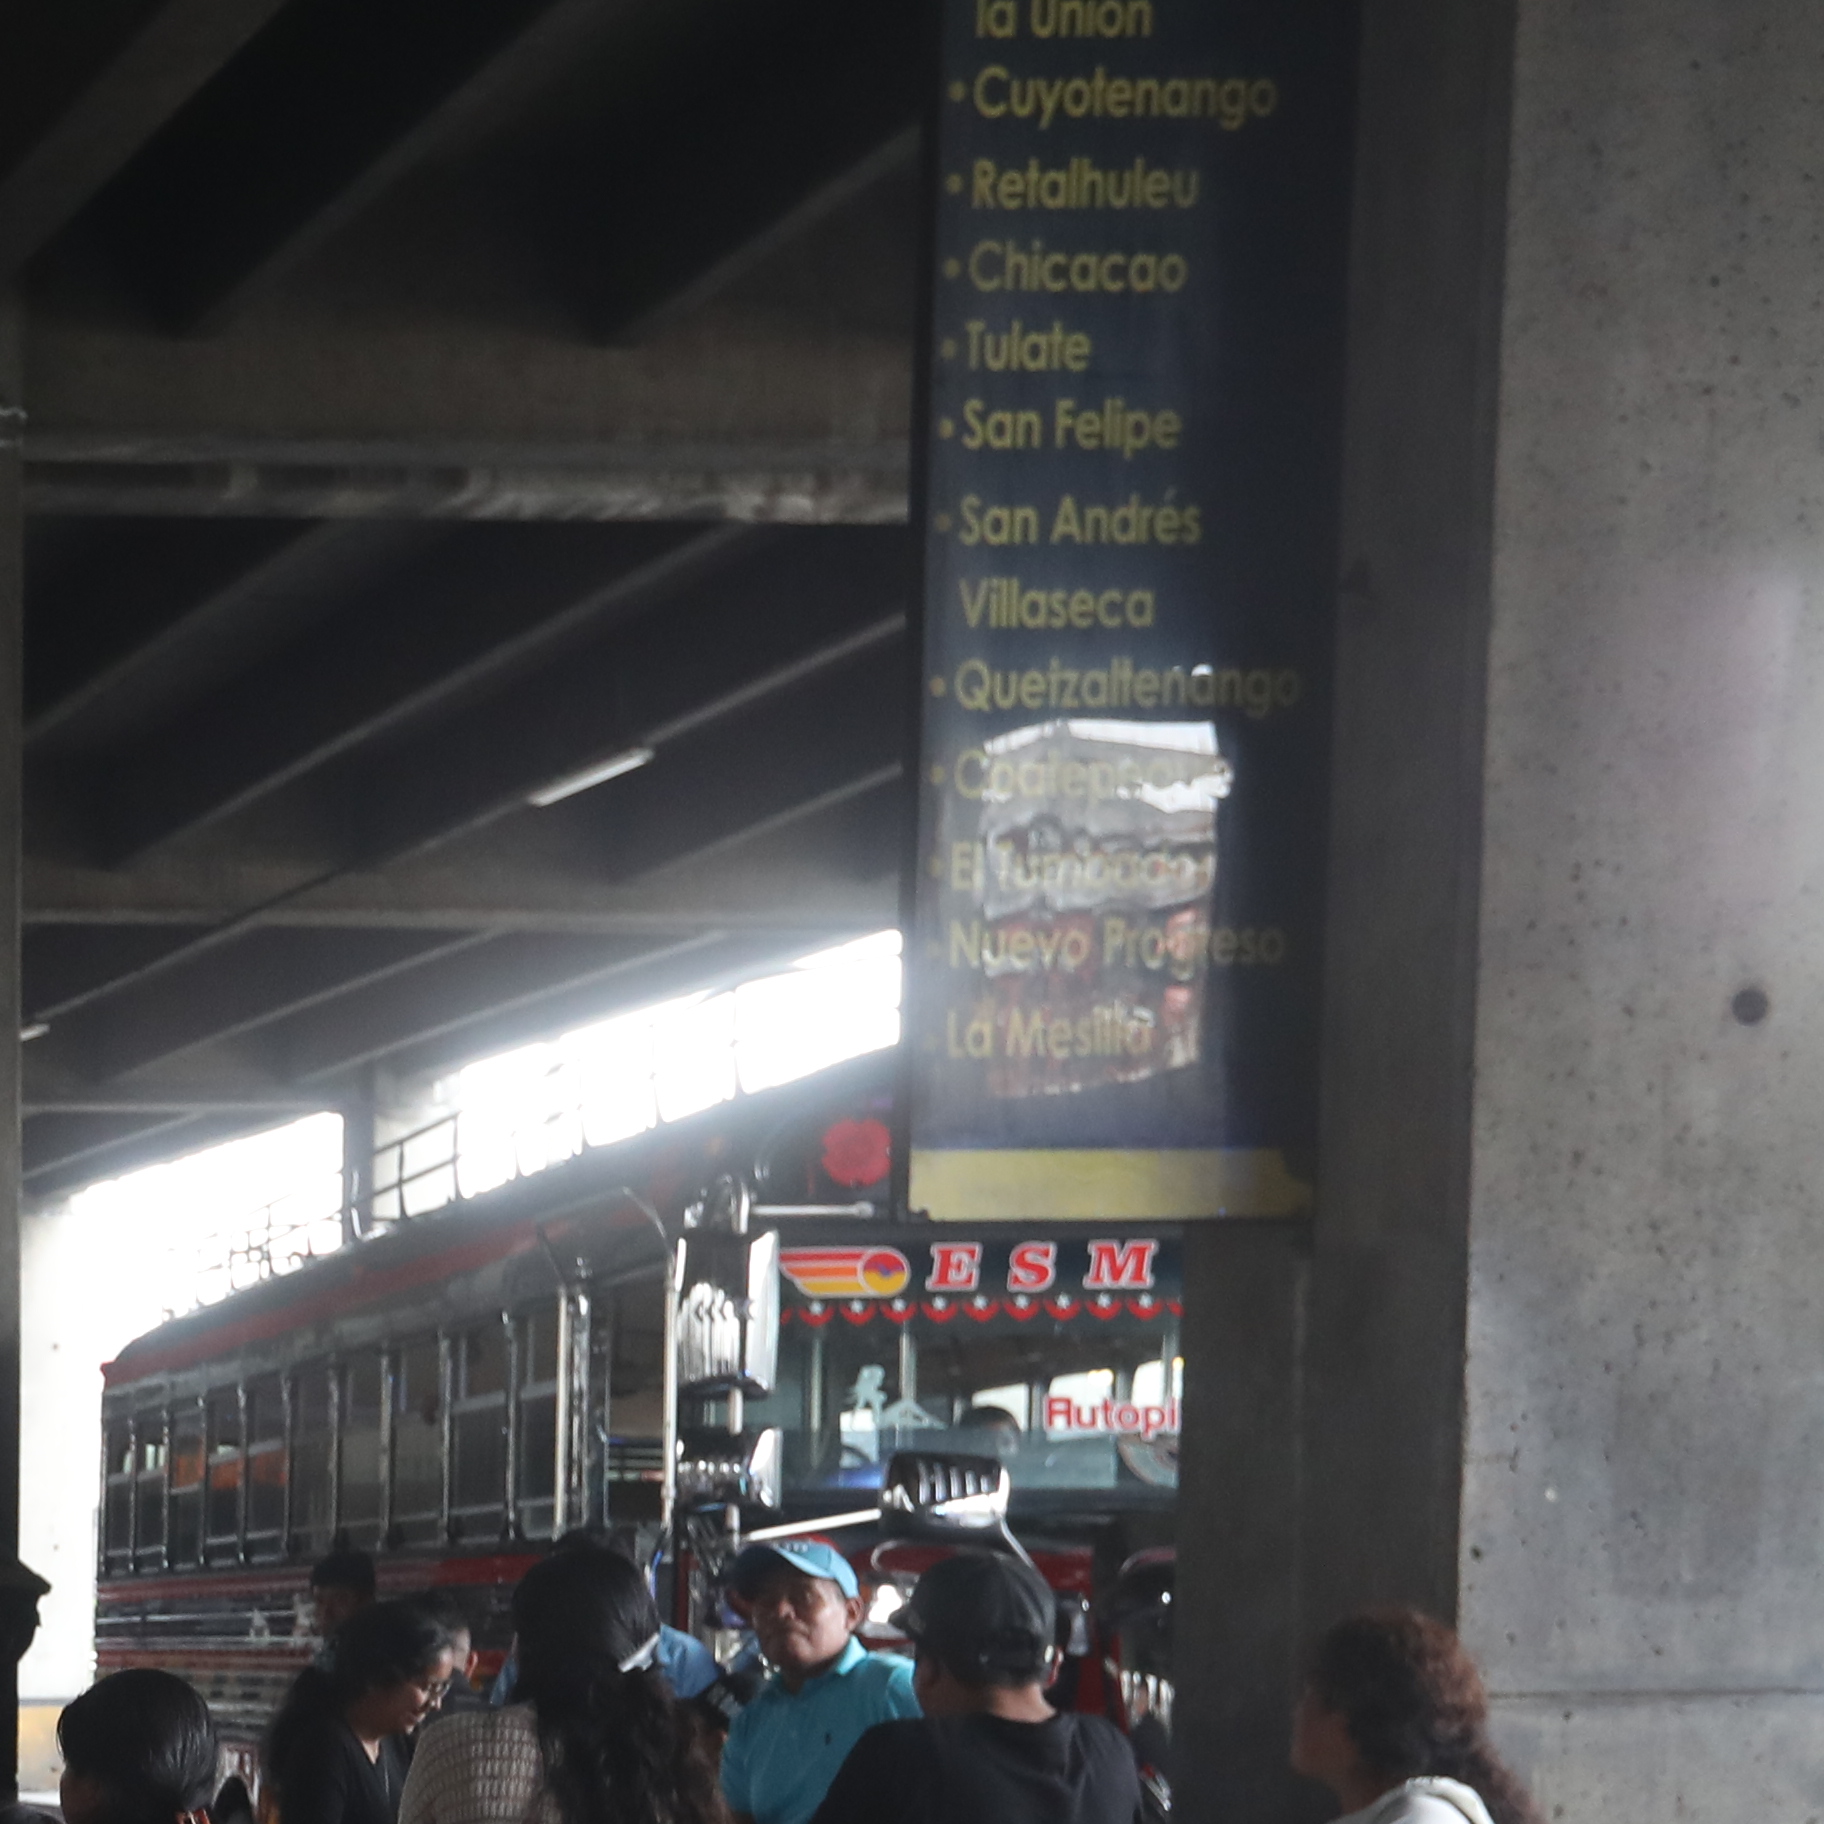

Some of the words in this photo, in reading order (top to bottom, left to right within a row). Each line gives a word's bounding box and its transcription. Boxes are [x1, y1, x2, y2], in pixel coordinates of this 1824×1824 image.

[973, 64, 1278, 131] Cuyotenango
[971, 158, 1200, 209] Retalhuleu
[969, 240, 1188, 292] Chicacao
[964, 320, 1092, 372] Tulate
[961, 398, 1042, 450] San
[1055, 397, 1182, 459] Felipe
[959, 495, 1037, 546] San
[1050, 488, 1202, 546] Andrés
[959, 577, 1154, 629] Villaseca
[955, 657, 1300, 716] Quetzaltenango
[948, 918, 1092, 968] Nuevo
[1102, 917, 1287, 981] Progreso
[1005, 1004, 1154, 1060] Mesilla
